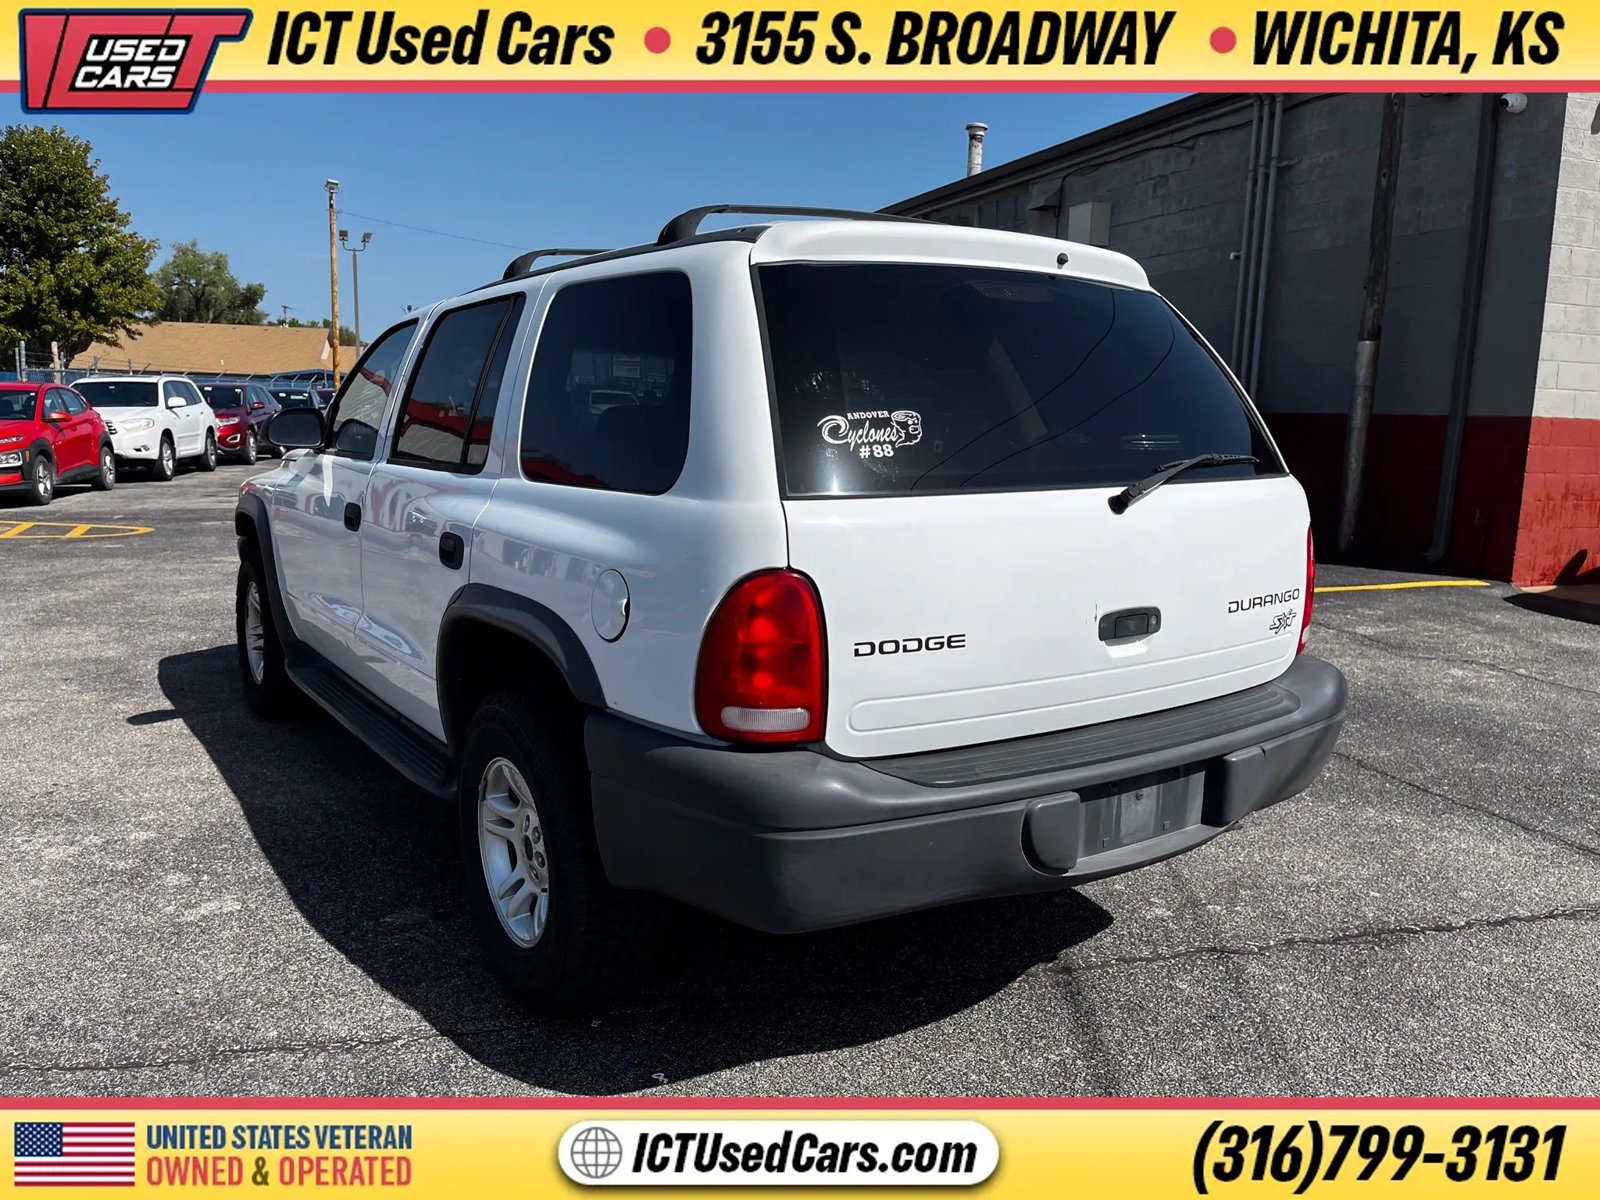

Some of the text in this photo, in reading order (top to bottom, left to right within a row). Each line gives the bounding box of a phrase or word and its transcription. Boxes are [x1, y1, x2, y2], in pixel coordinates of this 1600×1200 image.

[847, 410, 890, 420] ANDOVER
[817, 415, 900, 452] Cyclones
[859, 444, 894, 459] #88
[1228, 588, 1300, 614] DURANGO
[854, 633, 966, 658] DODGE
